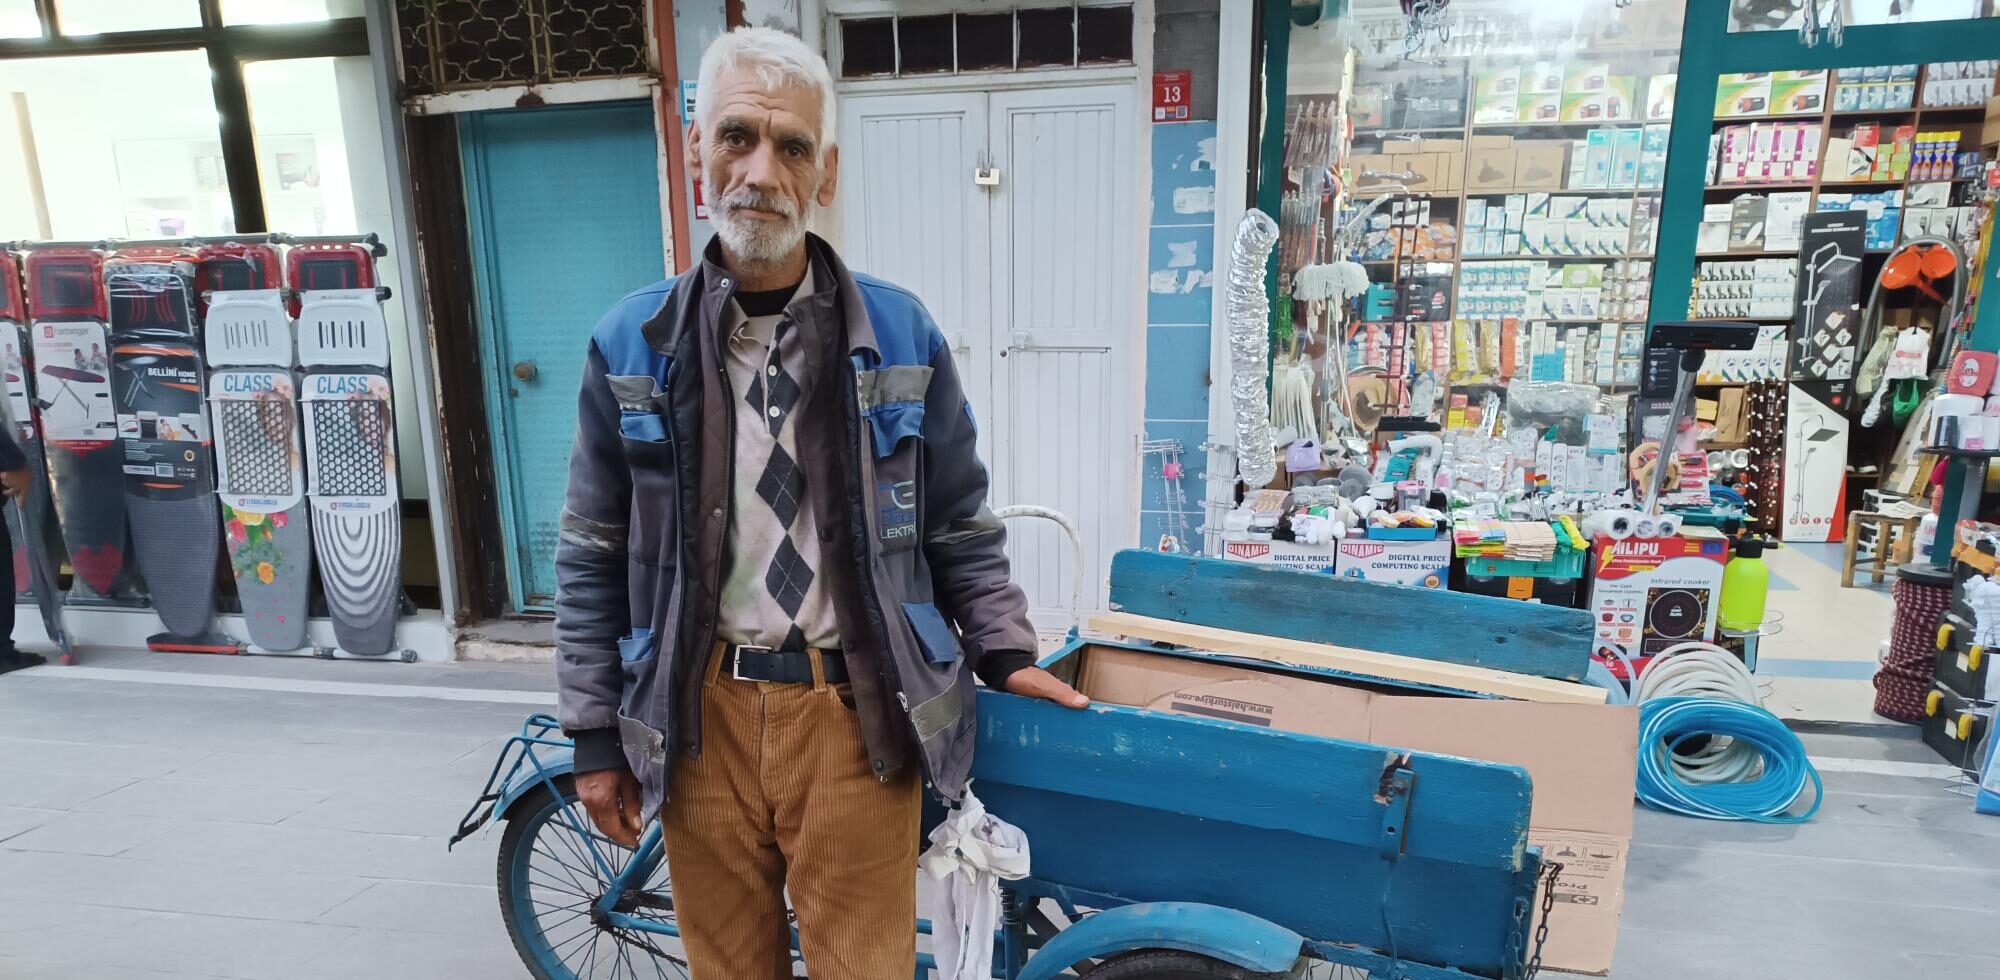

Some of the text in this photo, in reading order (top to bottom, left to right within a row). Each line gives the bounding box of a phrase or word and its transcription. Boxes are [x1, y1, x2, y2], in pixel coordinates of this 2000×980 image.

[1164, 86, 1181, 103] 13
[224, 374, 272, 392] CLASS
[317, 376, 368, 394] CLASS
[1227, 543, 1269, 558] DINAMIC
[1274, 554, 1305, 562] DIGITAL
[1341, 543, 1384, 558] DINAMIC
[1388, 554, 1420, 562] DIGITAL
[1371, 562, 1418, 570] COMPUTING
